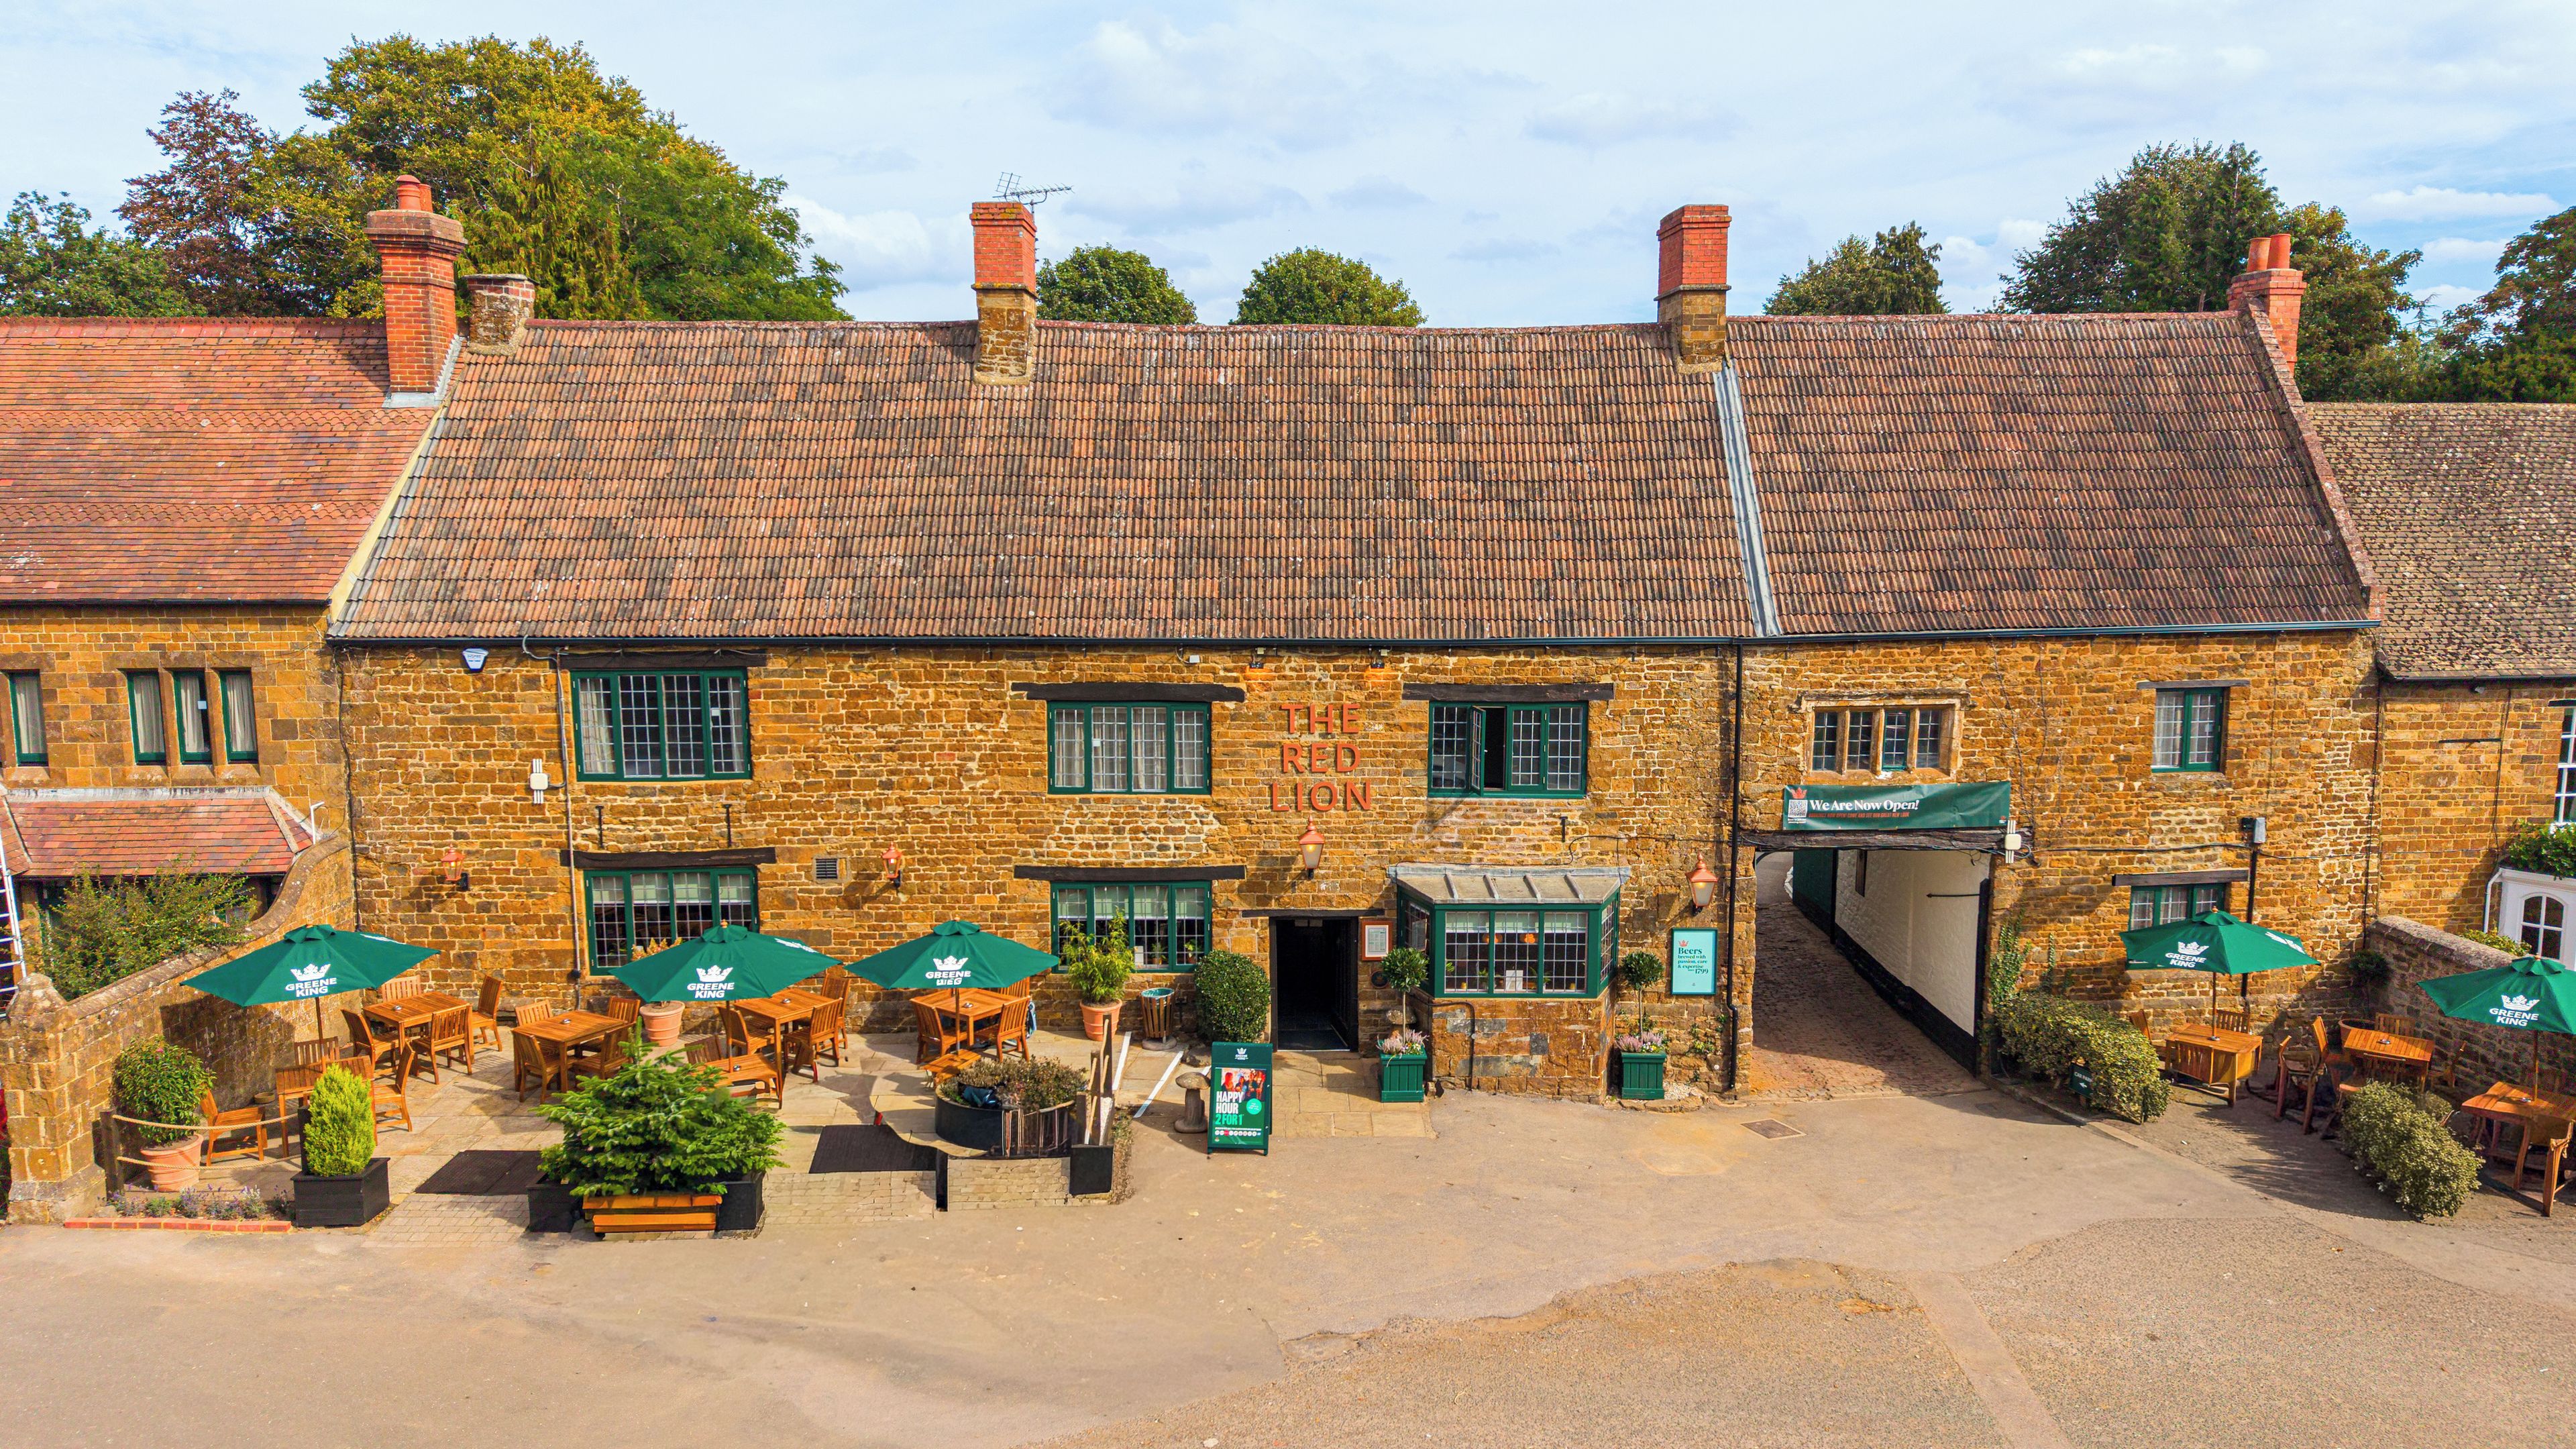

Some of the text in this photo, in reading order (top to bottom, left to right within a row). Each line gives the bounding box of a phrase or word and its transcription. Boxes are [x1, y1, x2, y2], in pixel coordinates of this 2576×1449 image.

[1281, 703, 1360, 734] THE
[1283, 743, 1360, 773] RED
[1272, 780, 1371, 811] LION
[1810, 799, 1919, 812] We Are Now Open!
[2165, 953, 2207, 963] GREENE
[2169, 959, 2196, 967] KING
[285, 977, 337, 991] GREENE
[687, 982, 735, 991] GREENE
[296, 985, 328, 998] KING
[695, 990, 725, 998] KING
[2489, 1008, 2539, 1020] GREENE
[2496, 1016, 2528, 1026] KING
[1216, 1091, 1244, 1103] HAPPY
[1216, 1102, 1238, 1114] HOUR
[1215, 1114, 1222, 1125] 2
[1222, 1114, 1236, 1125] FOR
